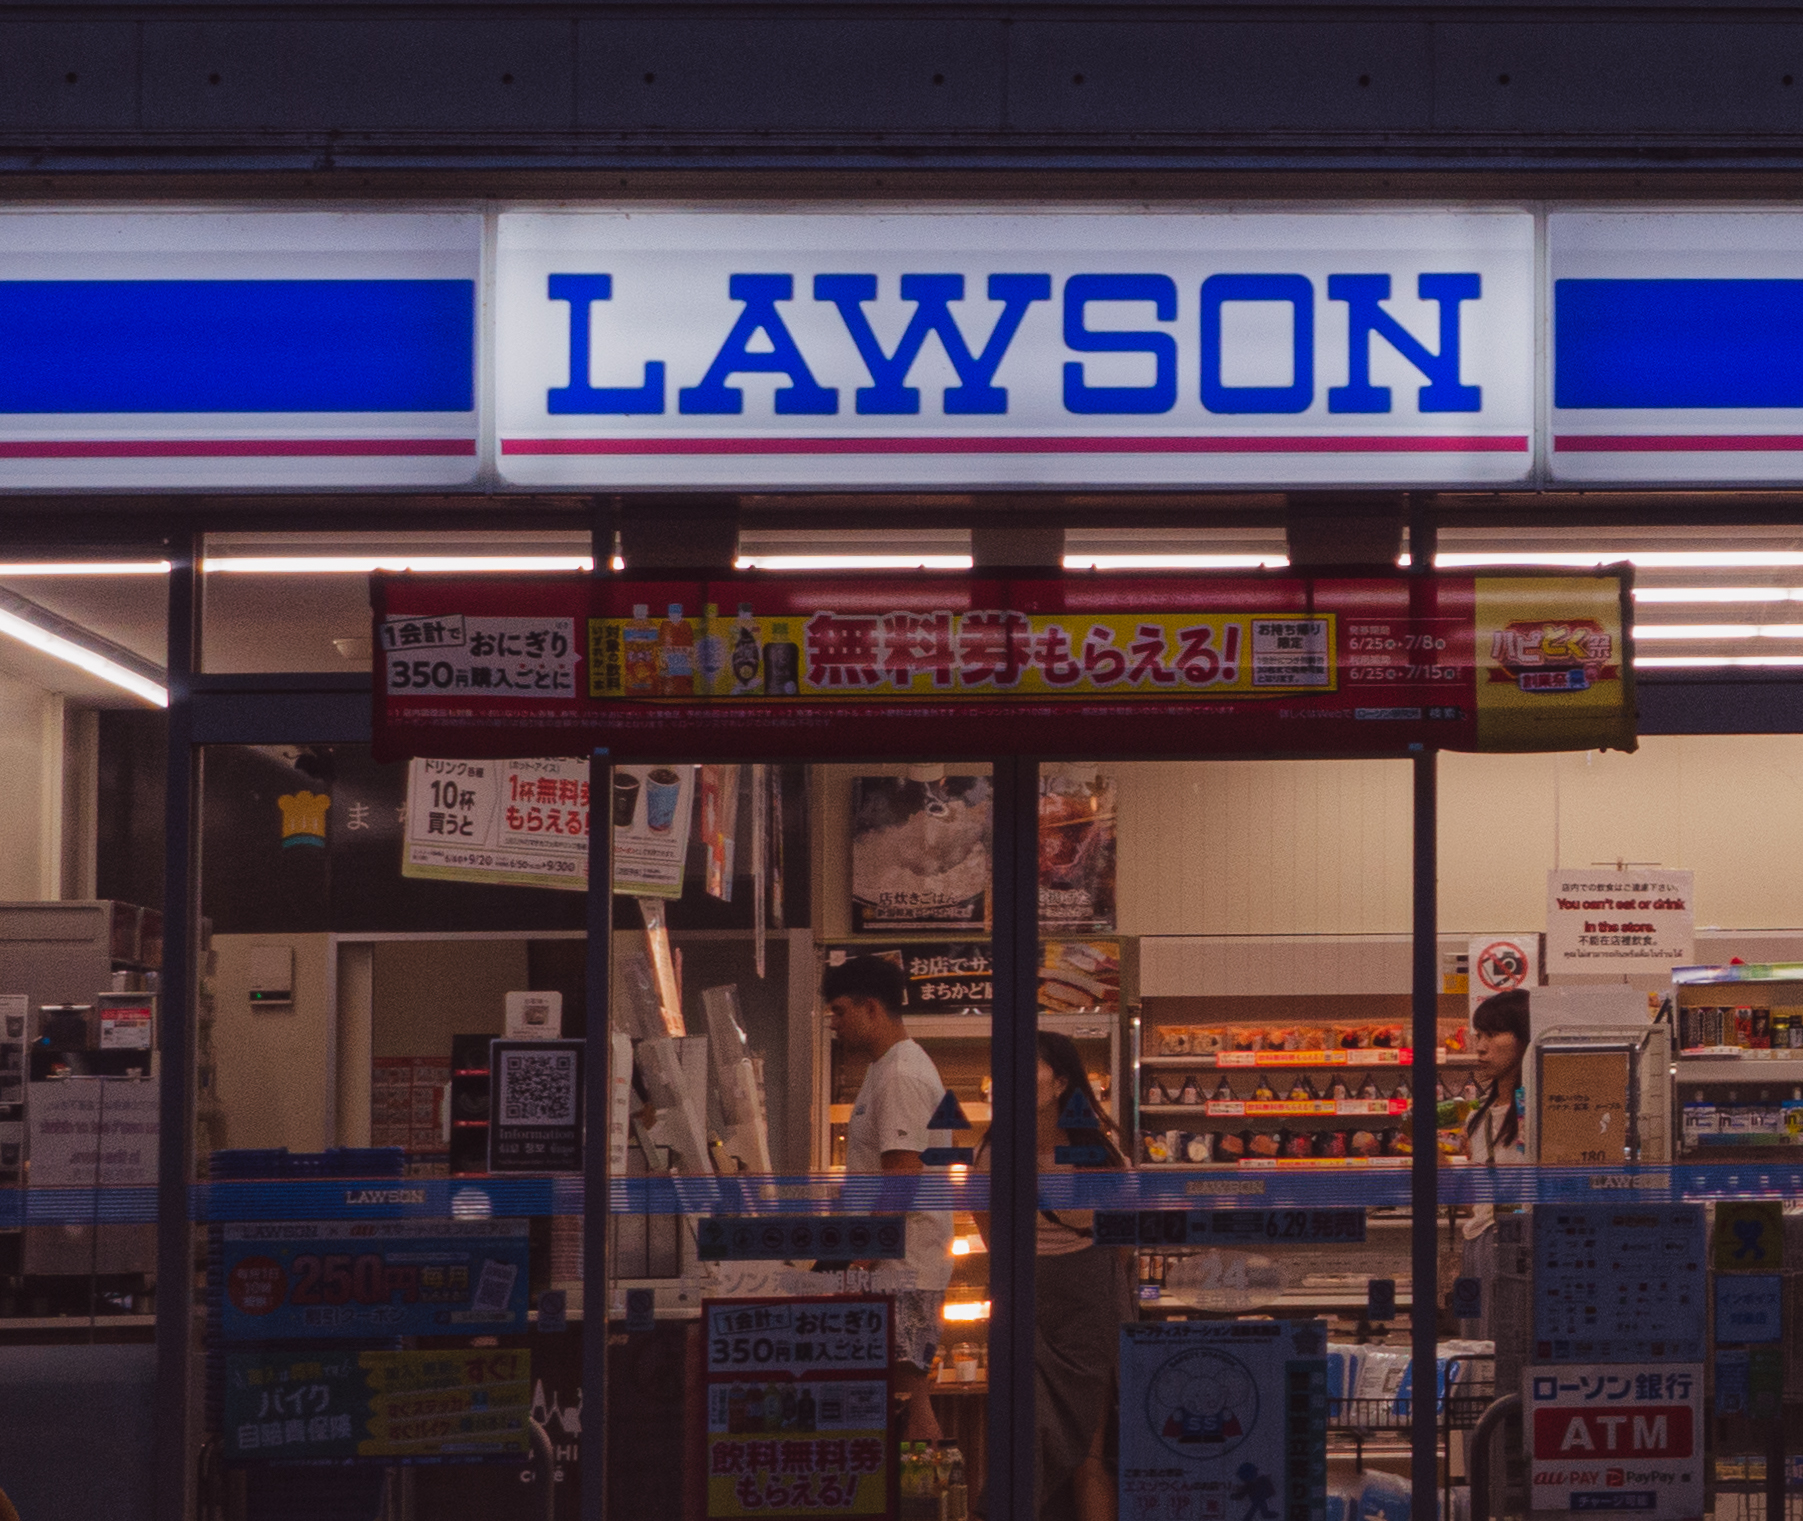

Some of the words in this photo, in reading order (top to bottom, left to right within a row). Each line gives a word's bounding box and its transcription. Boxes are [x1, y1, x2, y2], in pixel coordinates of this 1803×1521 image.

[548, 273, 1482, 415] LAWSON
[384, 620, 462, 647] 1会計で
[470, 630, 569, 658] おにぎり
[805, 611, 1240, 690] 無料券もらえる!
[391, 660, 572, 690] 350円購入ごとに
[430, 780, 476, 811] 10杯
[428, 811, 474, 836] 買うと
[1557, 898, 1580, 910] You
[1582, 898, 1614, 910] can't
[1616, 899, 1637, 910] eat
[1638, 901, 1651, 910] or
[1653, 898, 1686, 910] drink
[1598, 921, 1619, 933] the
[909, 956, 993, 976] お店でサ
[498, 1129, 576, 1142] Information
[345, 1189, 427, 1205] LAWSON
[795, 1311, 882, 1335] おにぎり
[712, 1338, 884, 1365] 350円購入ごとに
[1533, 1372, 1694, 1401] ローソン銀行
[257, 1383, 331, 1420] バイク
[237, 1413, 353, 1451] 自賠責保険
[1560, 1414, 1668, 1452] ATM
[711, 1438, 884, 1475] 飲料無料券
[735, 1475, 859, 1508] もらえる!
[1569, 1471, 1600, 1485] PAY
[1626, 1470, 1676, 1485] PayPay
